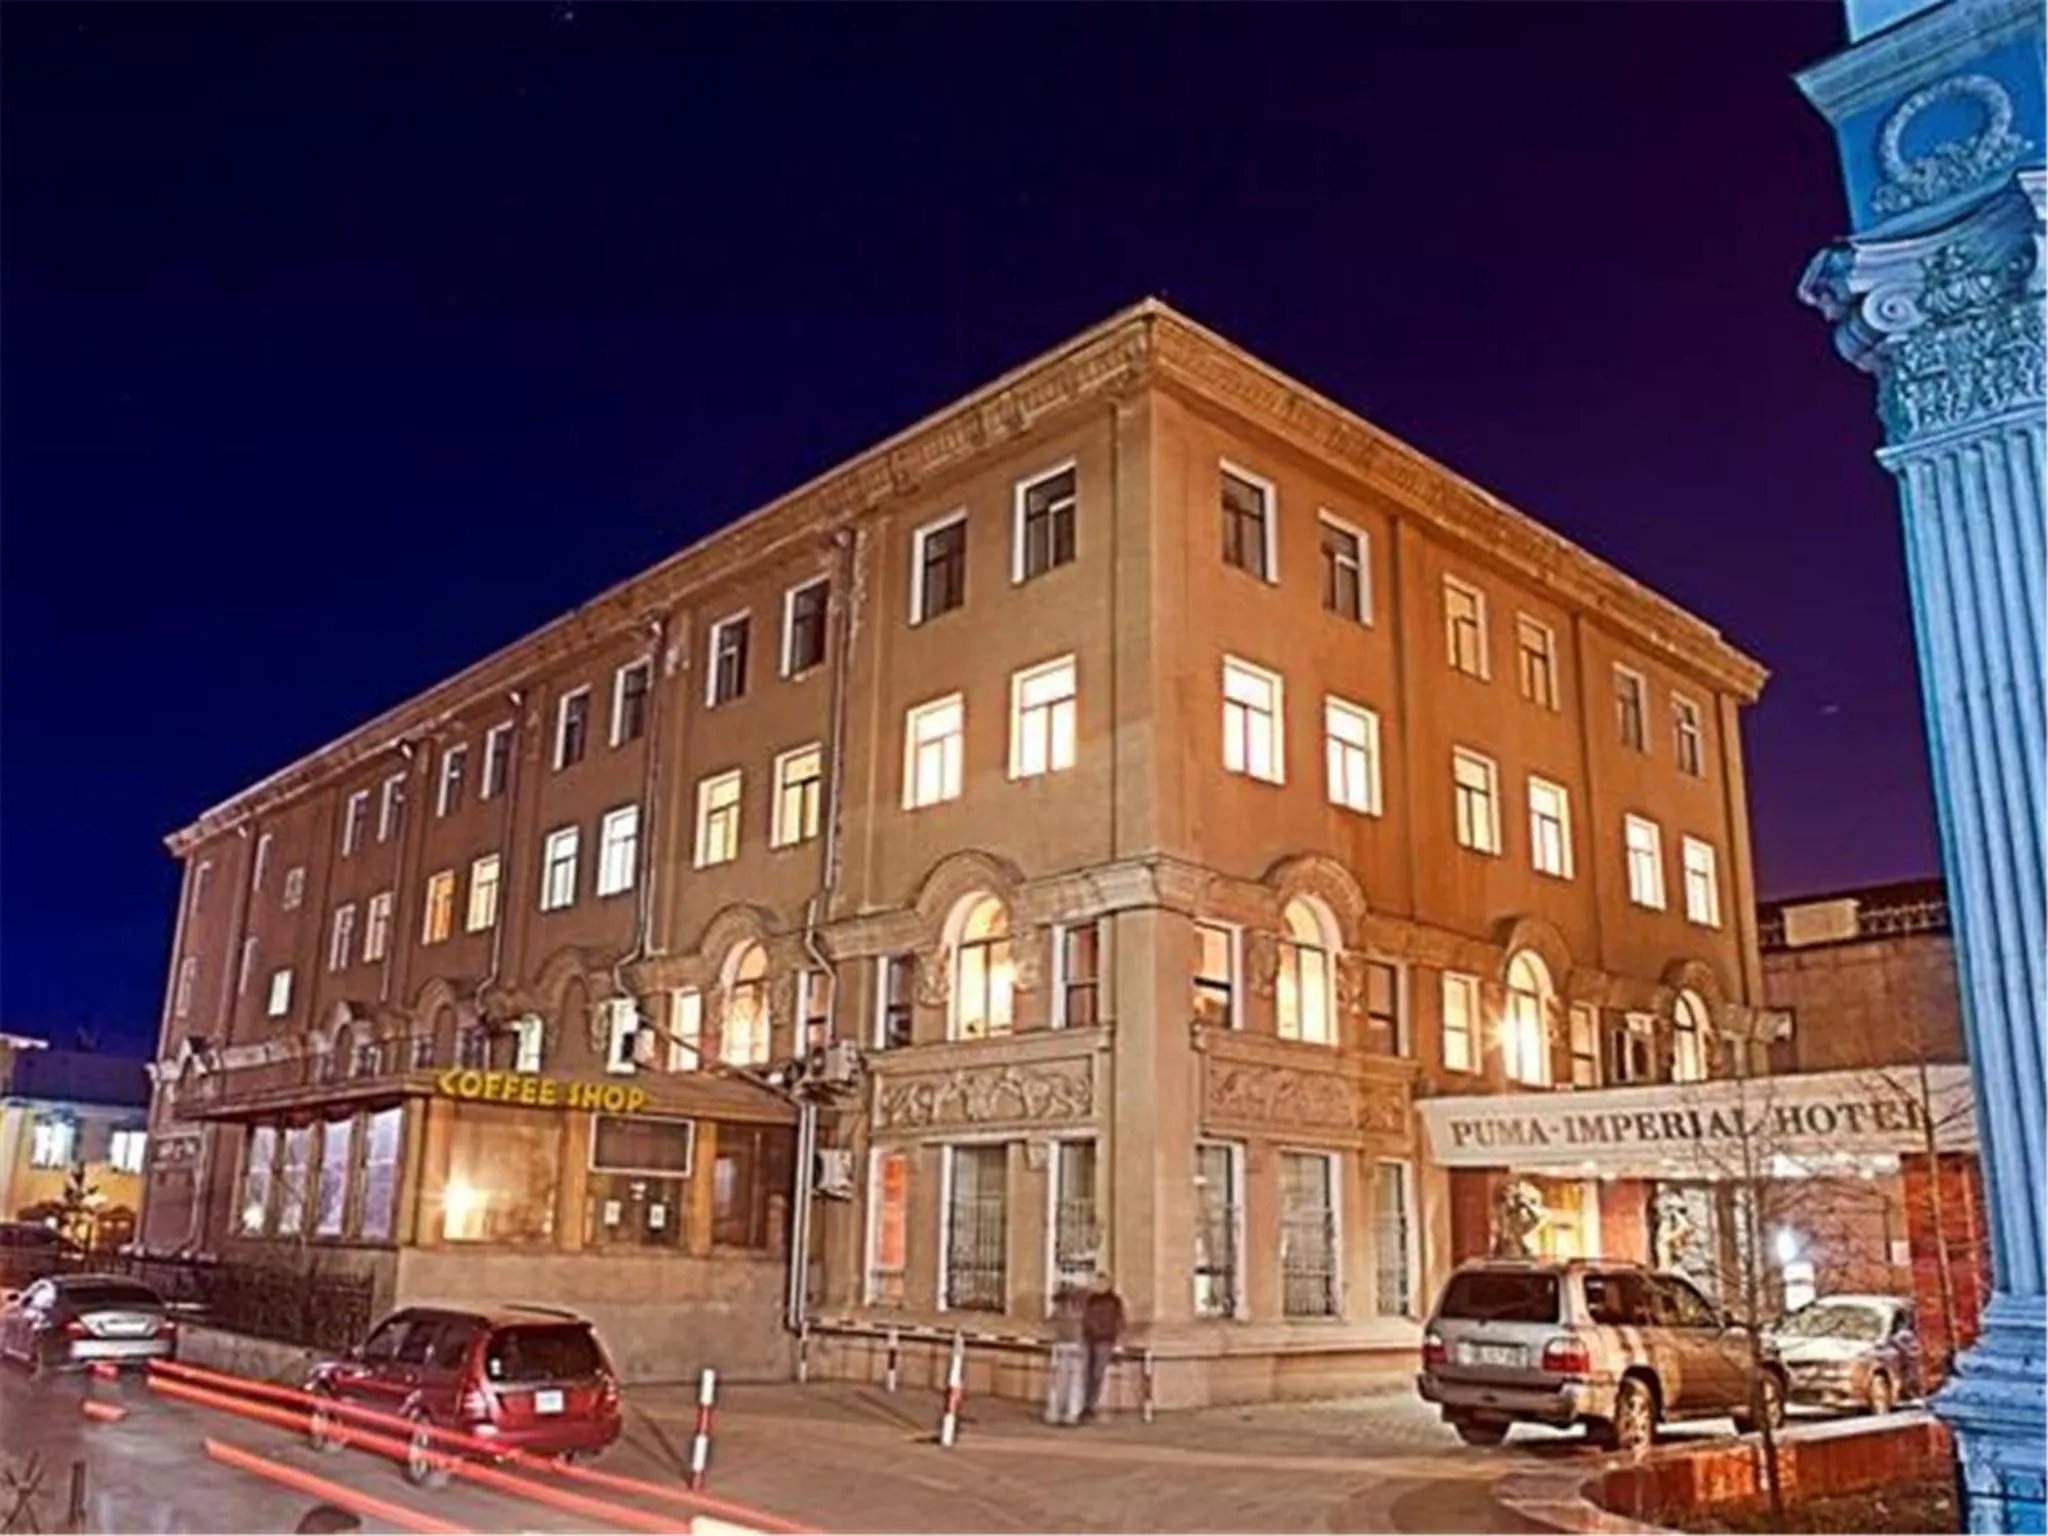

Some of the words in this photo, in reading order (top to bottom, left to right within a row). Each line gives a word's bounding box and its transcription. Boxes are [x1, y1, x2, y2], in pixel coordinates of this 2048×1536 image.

[438, 1071, 556, 1105] COFFEE
[568, 1082, 646, 1112] SHOP
[1774, 1097, 1930, 1136] HOTEL
